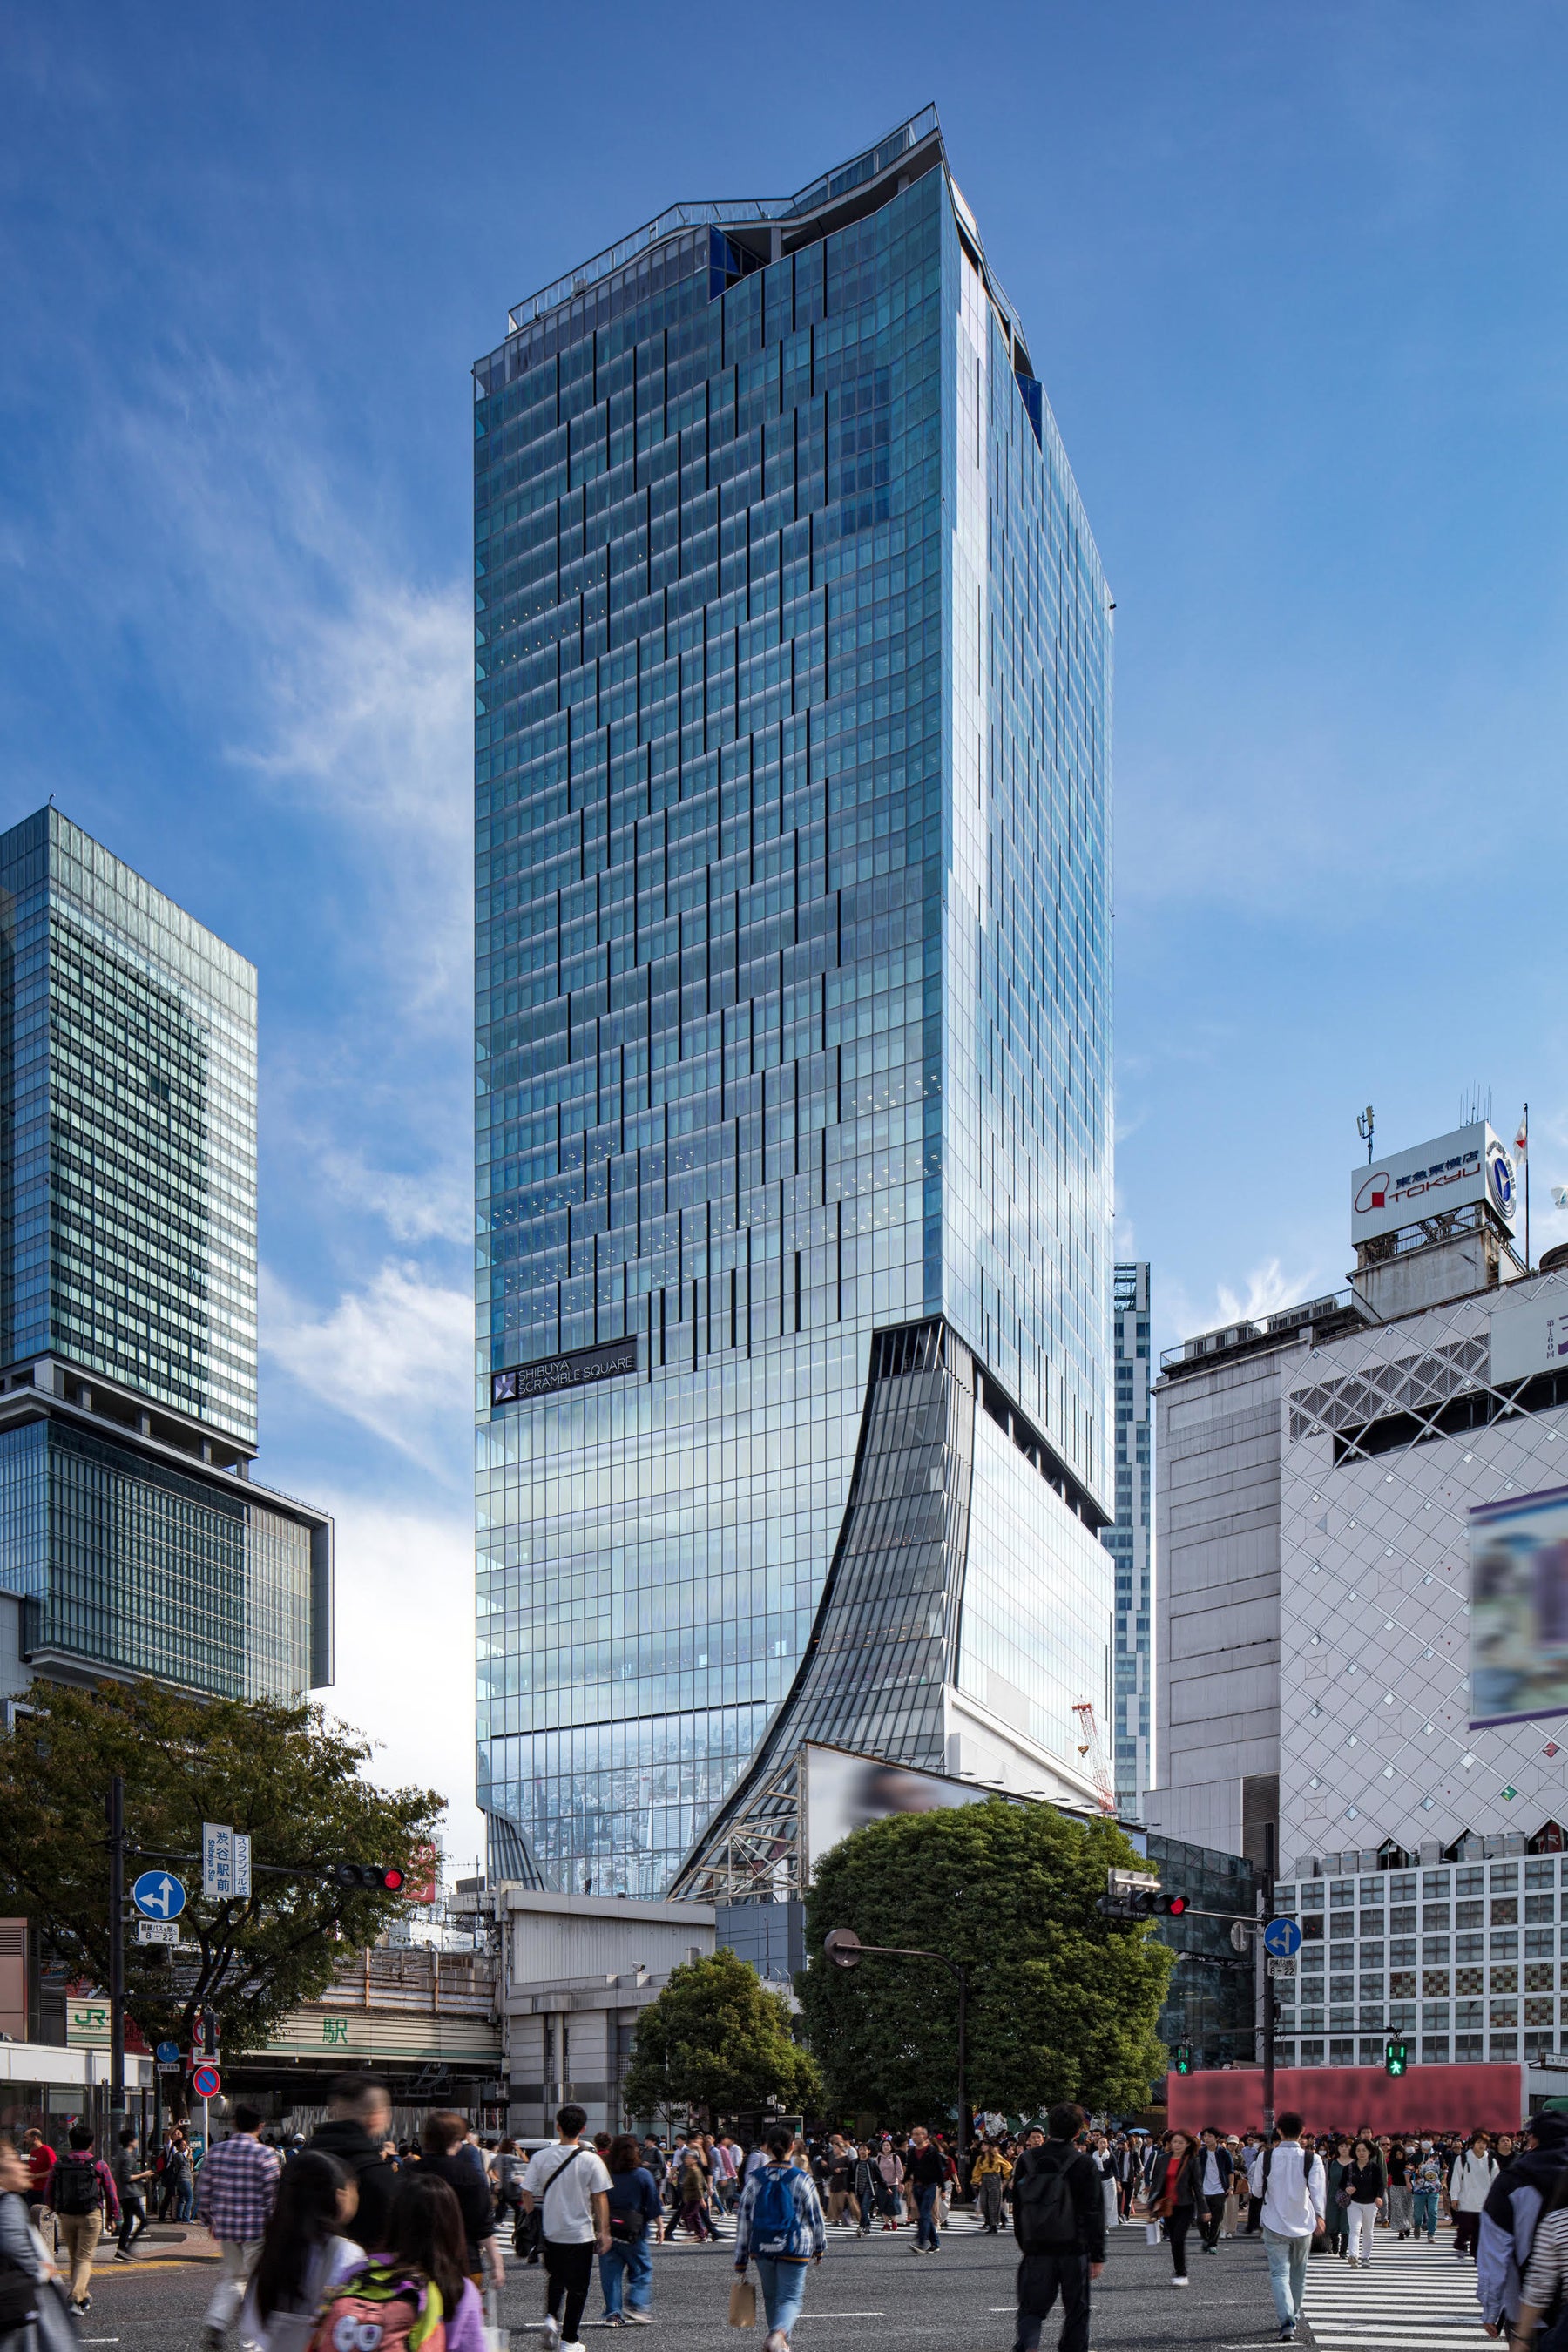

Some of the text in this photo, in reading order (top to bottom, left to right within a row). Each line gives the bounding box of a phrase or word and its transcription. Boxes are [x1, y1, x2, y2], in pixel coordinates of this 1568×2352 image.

[1389, 1163, 1480, 1202] TOKYU
[1396, 1150, 1479, 1189] 東急東横店
[518, 1360, 570, 1382] SHIBUYA
[518, 1355, 633, 1394] SCRAMBLE SQUARE
[216, 1831, 230, 1893] 渋谷駅前
[237, 1837, 248, 1895] スクランブル式
[74, 2009, 105, 2025] JR
[322, 2017, 348, 2044] 駅
